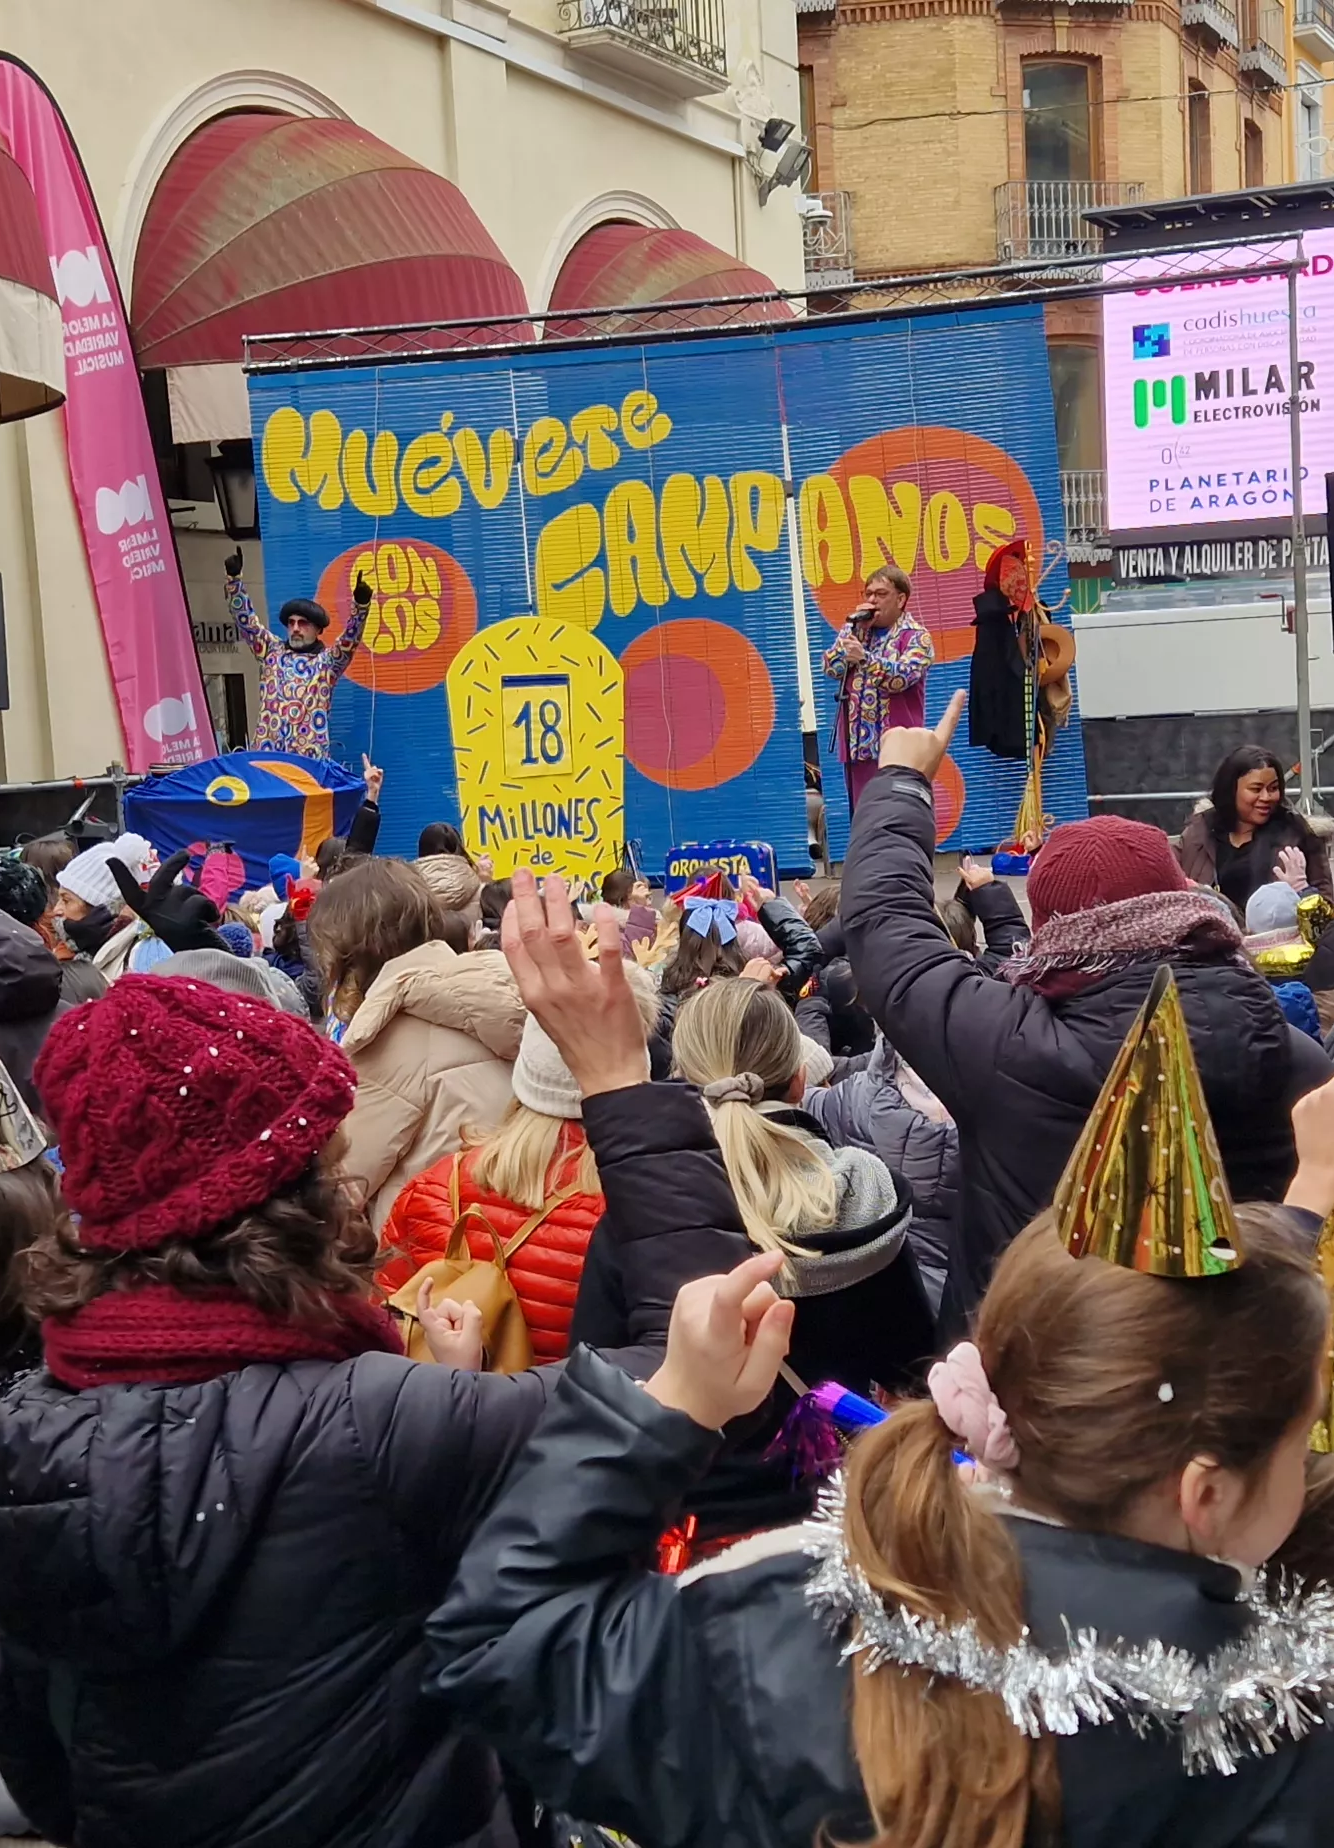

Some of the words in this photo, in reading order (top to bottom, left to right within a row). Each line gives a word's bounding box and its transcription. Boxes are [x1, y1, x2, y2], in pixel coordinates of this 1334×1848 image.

[1194, 361, 1316, 401] MILAR
[1193, 396, 1321, 424] ELECTROVISÓN
[1149, 466, 1309, 493] PLANETARIO
[1150, 497, 1176, 513] DE
[1119, 548, 1164, 579] VENTA
[1168, 546, 1179, 575] Y
[1183, 541, 1254, 576] ALQUILER
[1258, 539, 1277, 569] DE
[362, 597, 441, 654] LOS
[513, 699, 565, 766] 18
[530, 843, 554, 865] de
